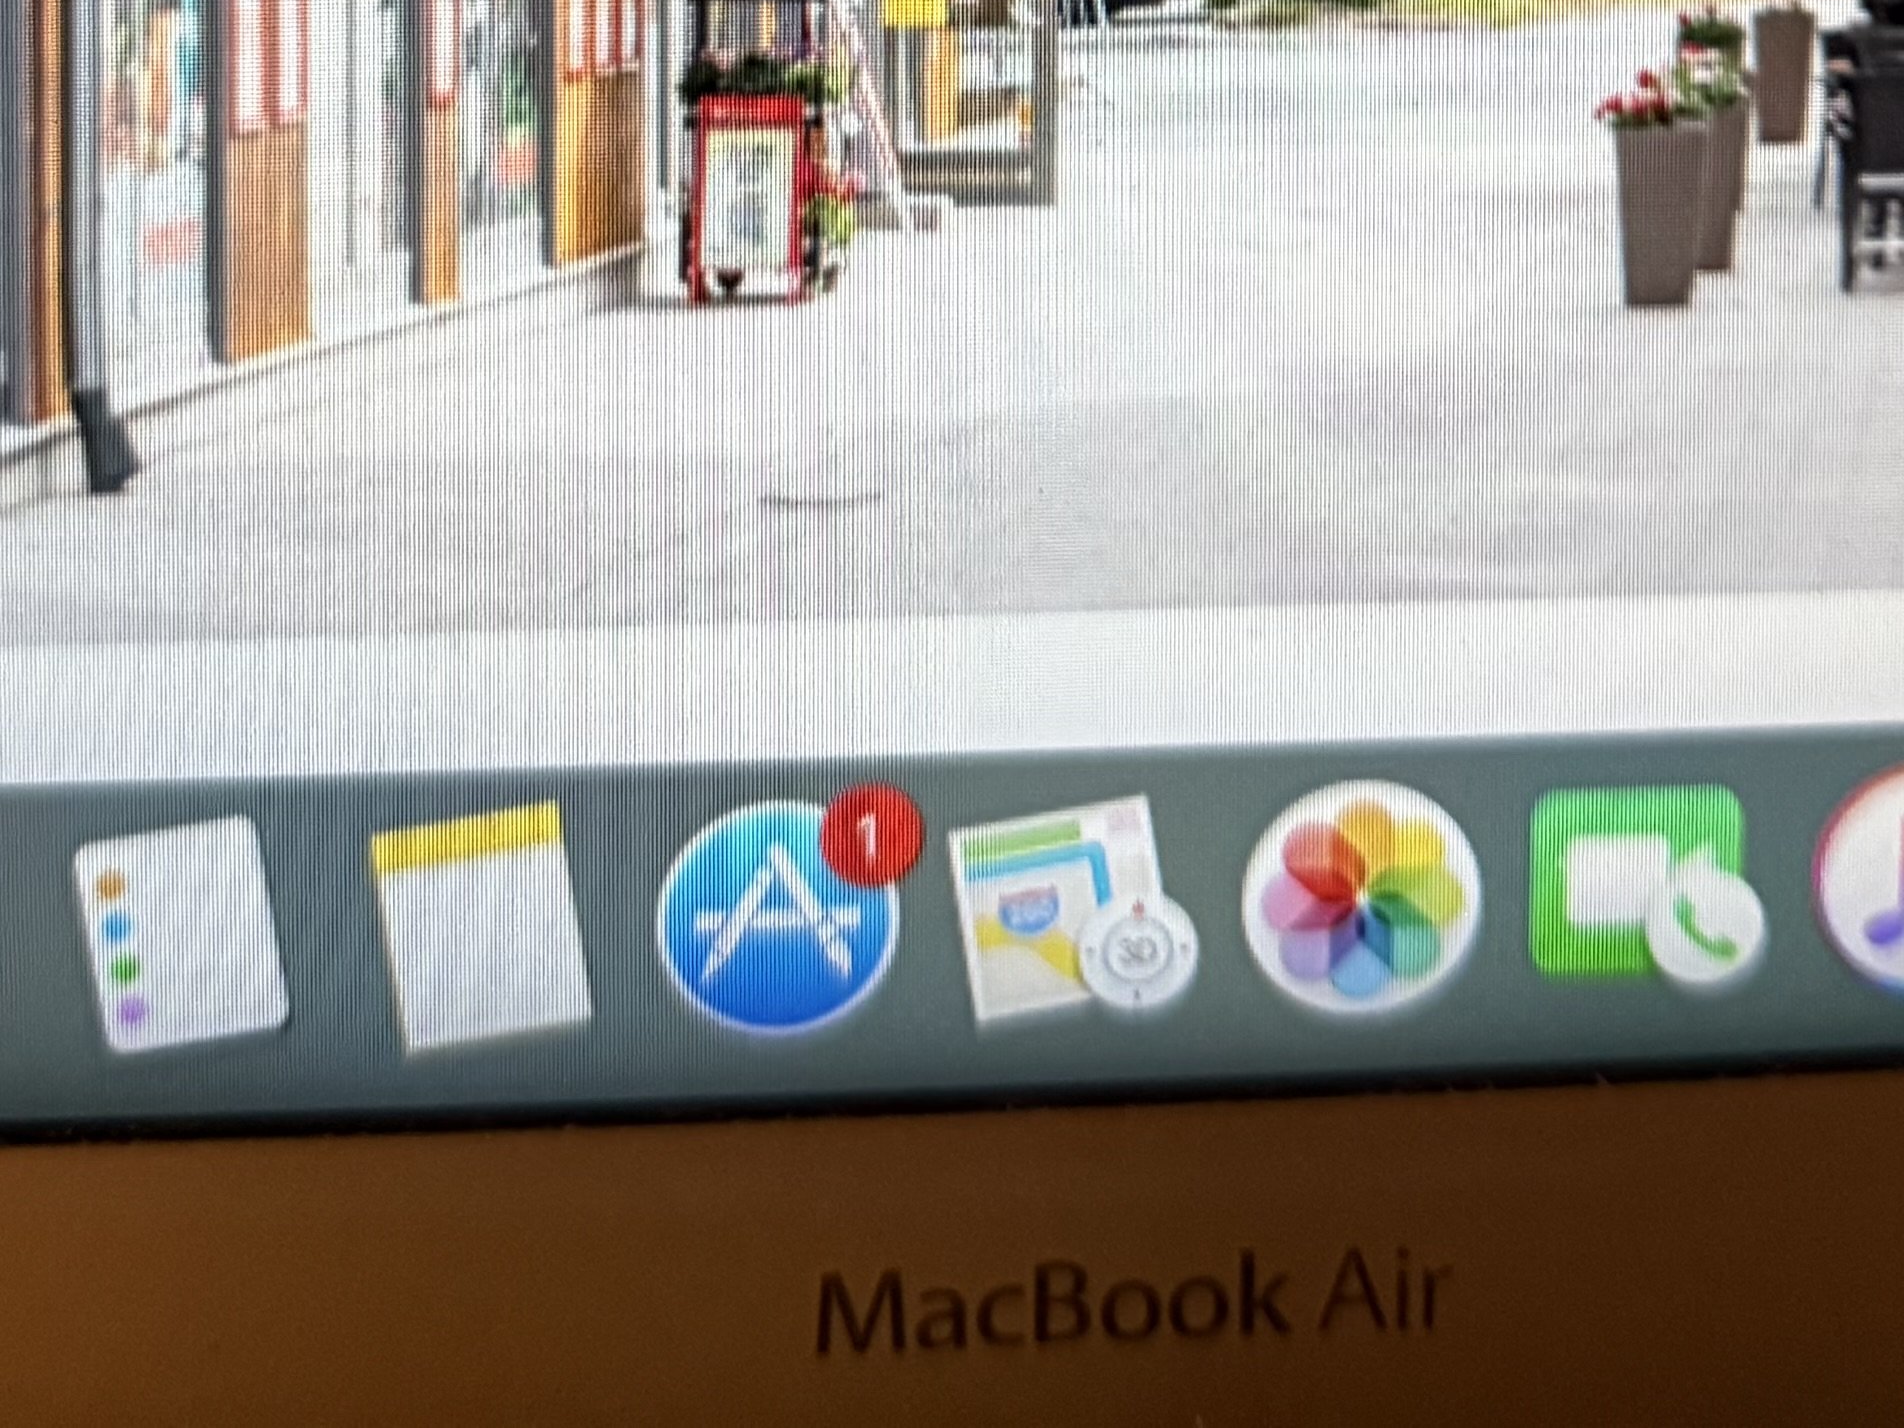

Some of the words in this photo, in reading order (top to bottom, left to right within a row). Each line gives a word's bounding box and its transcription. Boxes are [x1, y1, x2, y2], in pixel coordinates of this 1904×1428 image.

[857, 812, 877, 859] 1
[814, 1247, 1294, 1359] MacBook
[1317, 1246, 1454, 1338] Air
